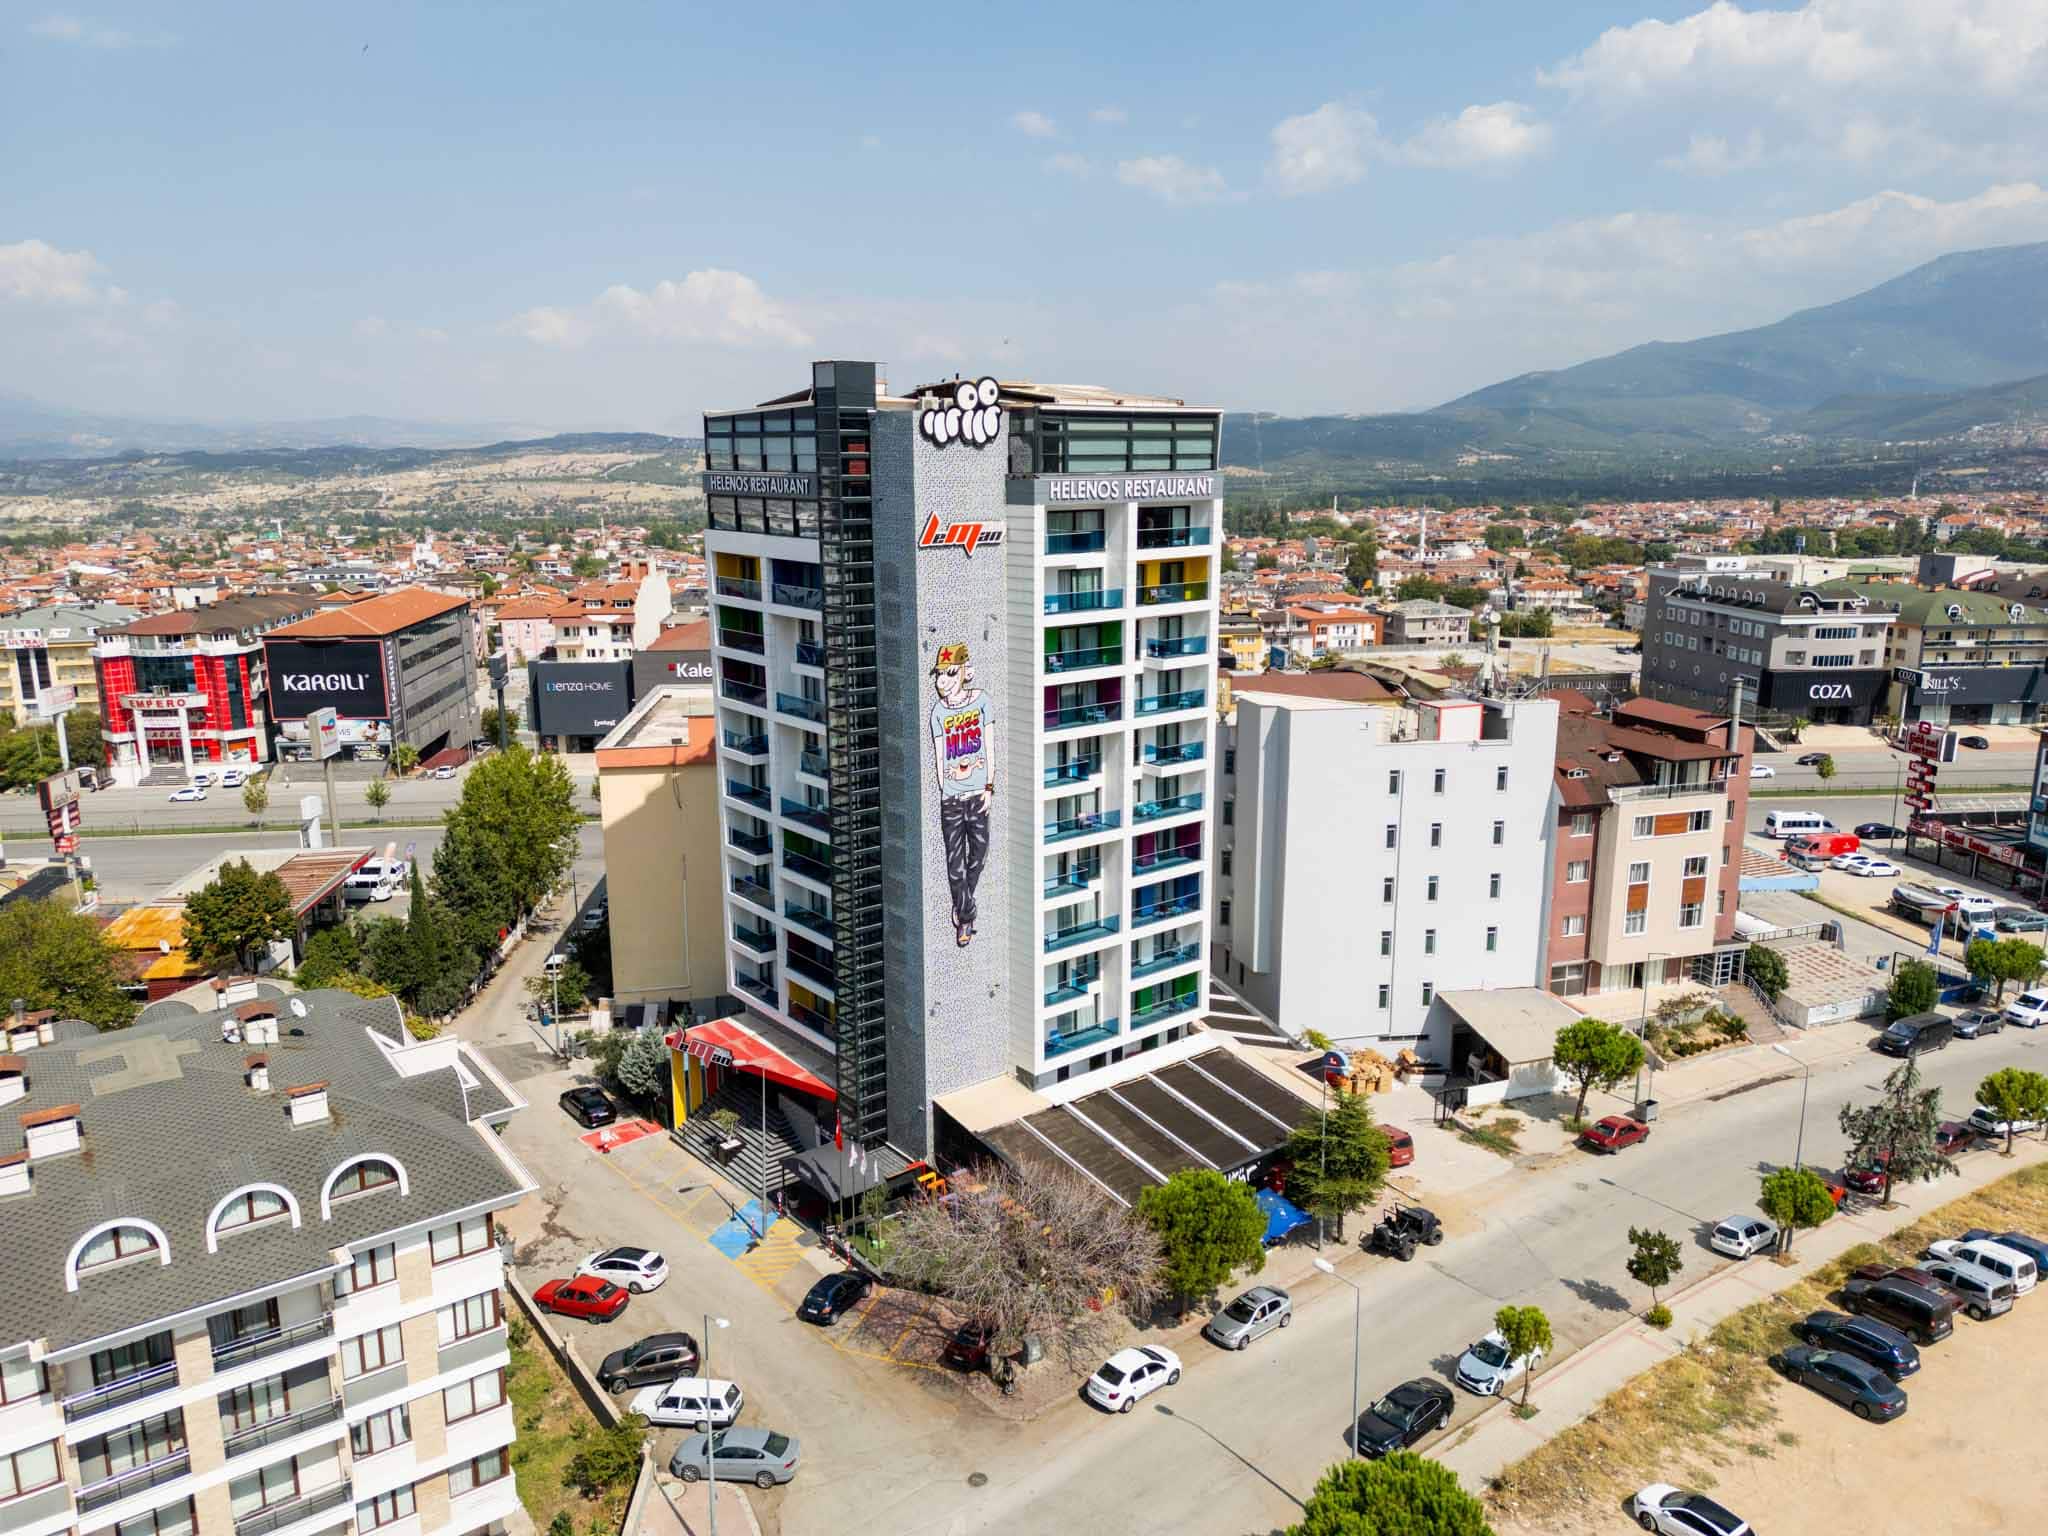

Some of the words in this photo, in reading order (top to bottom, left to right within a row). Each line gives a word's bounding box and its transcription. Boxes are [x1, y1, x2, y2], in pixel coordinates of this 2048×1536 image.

[710, 475, 749, 492] HELENOS
[750, 477, 809, 495] RESTAURANT
[1050, 480, 1120, 500] HELENOS
[1124, 477, 1214, 499] RESTAURANT
[676, 663, 713, 678] Kale
[585, 683, 613, 691] HOME
[1809, 684, 1852, 699] COZA
[128, 699, 186, 708] EMPERO
[944, 708, 980, 734] FREE
[946, 727, 982, 760] HUGS
